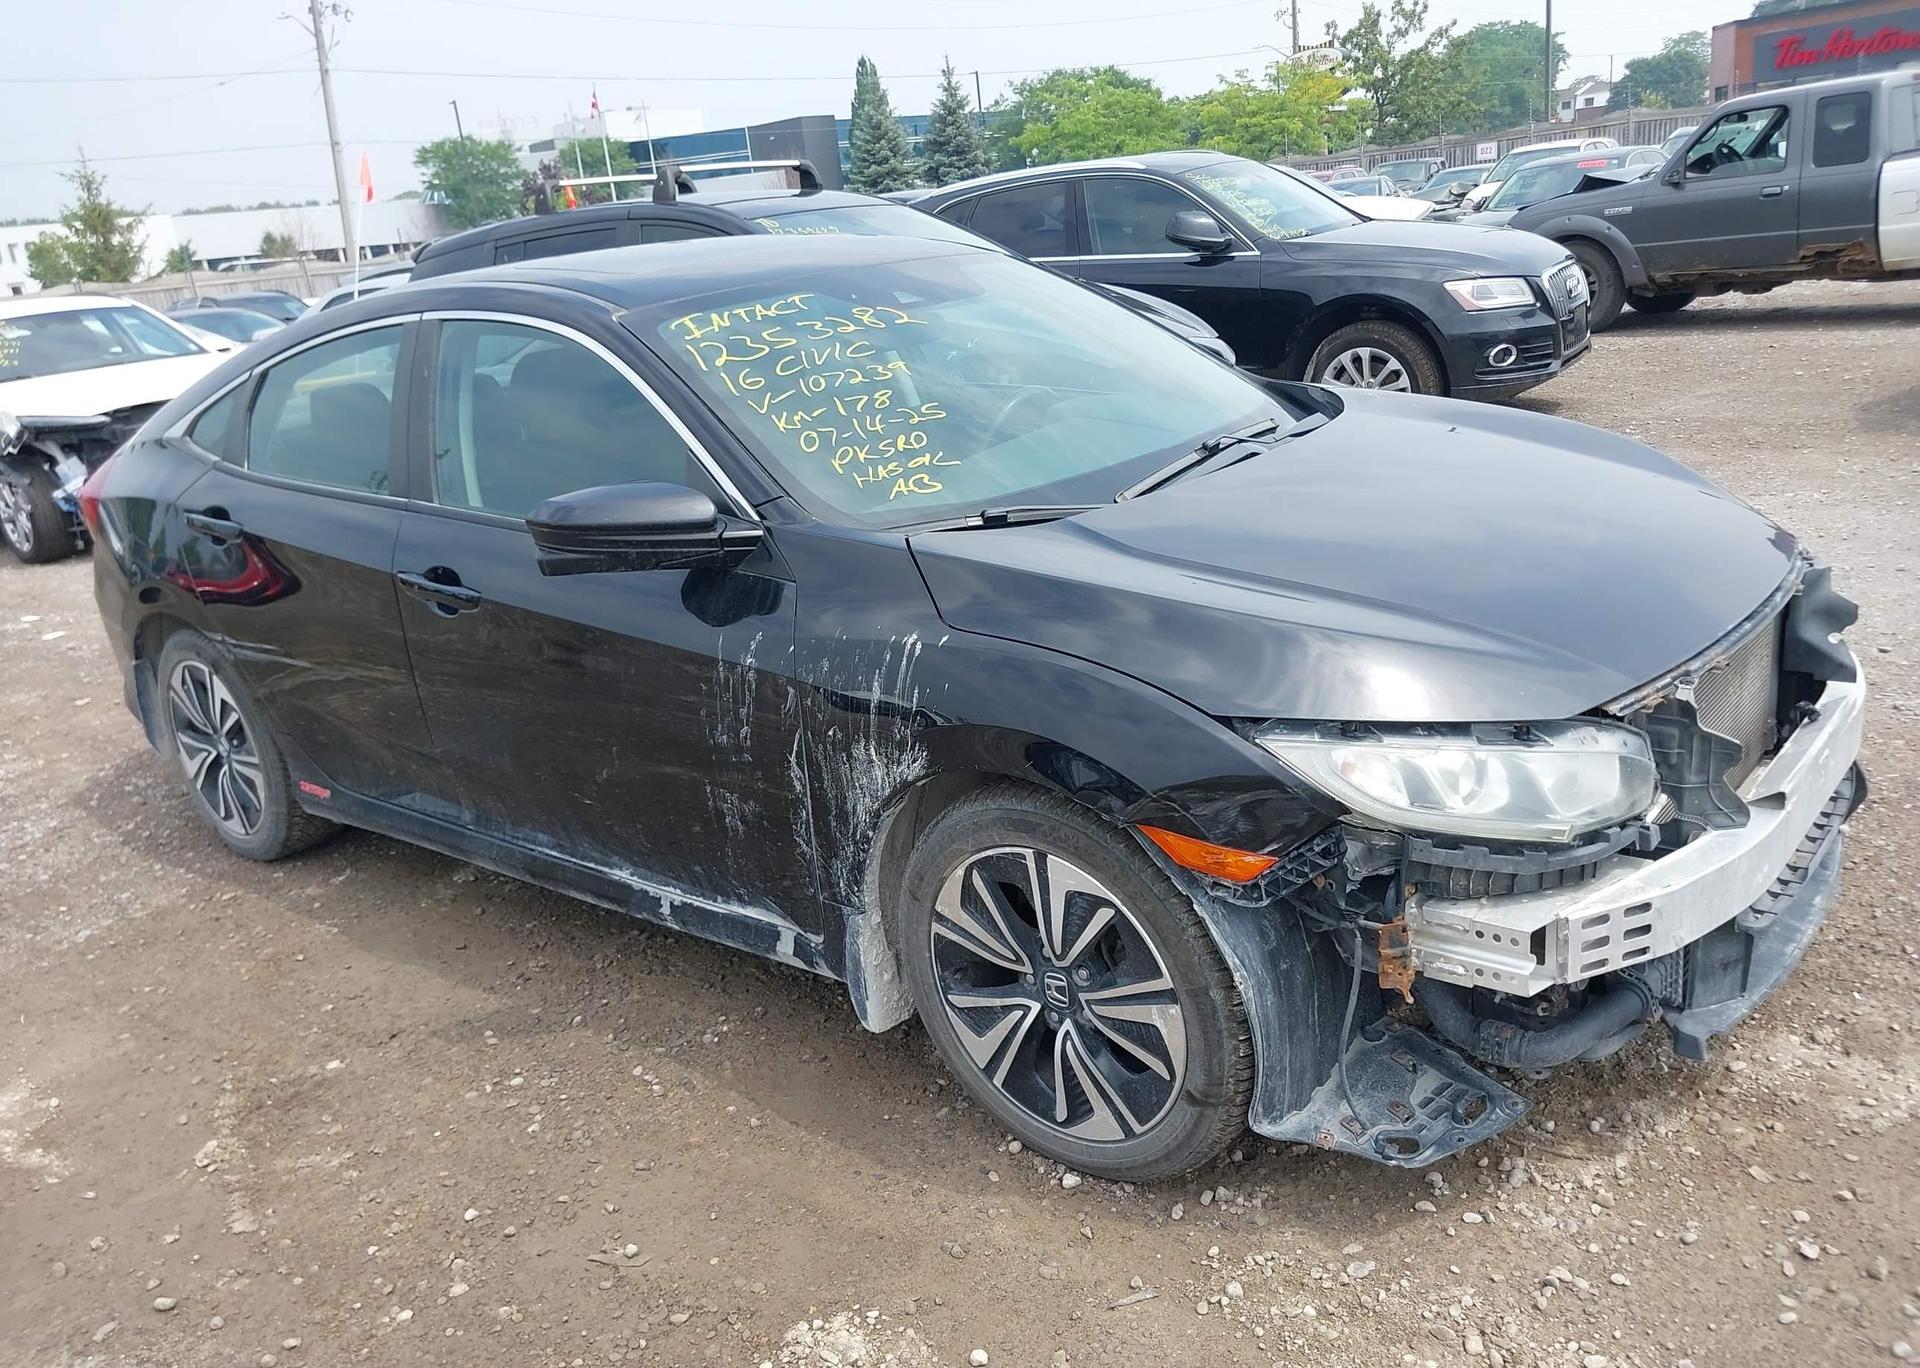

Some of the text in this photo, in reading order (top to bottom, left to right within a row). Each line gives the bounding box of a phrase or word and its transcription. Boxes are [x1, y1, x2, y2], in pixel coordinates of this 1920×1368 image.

[1774, 35, 1818, 69] Tim
[671, 294, 815, 341] INTACT
[685, 307, 928, 372] 12353282
[720, 342, 877, 397] 16 CIVIC
